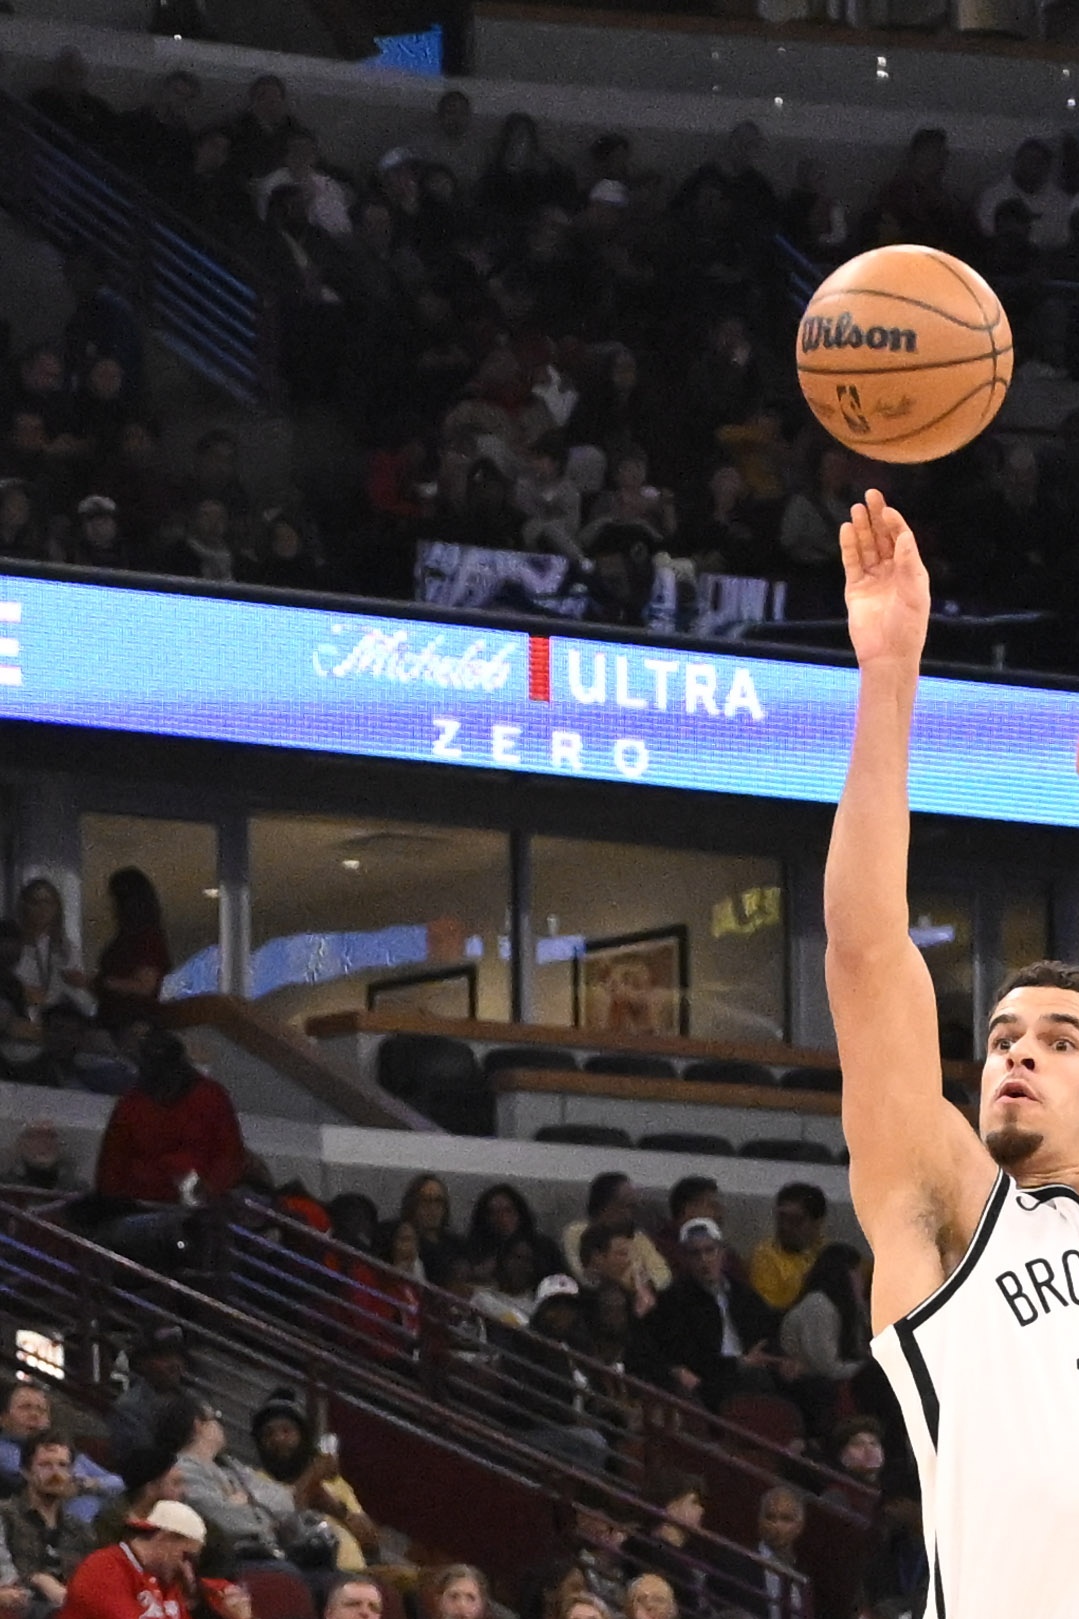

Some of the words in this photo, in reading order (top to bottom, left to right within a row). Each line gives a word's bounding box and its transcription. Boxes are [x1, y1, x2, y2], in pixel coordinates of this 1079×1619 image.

[802, 311, 918, 354] Wilson
[567, 648, 765, 721] ULTRA
[432, 718, 650, 778] ZERO
